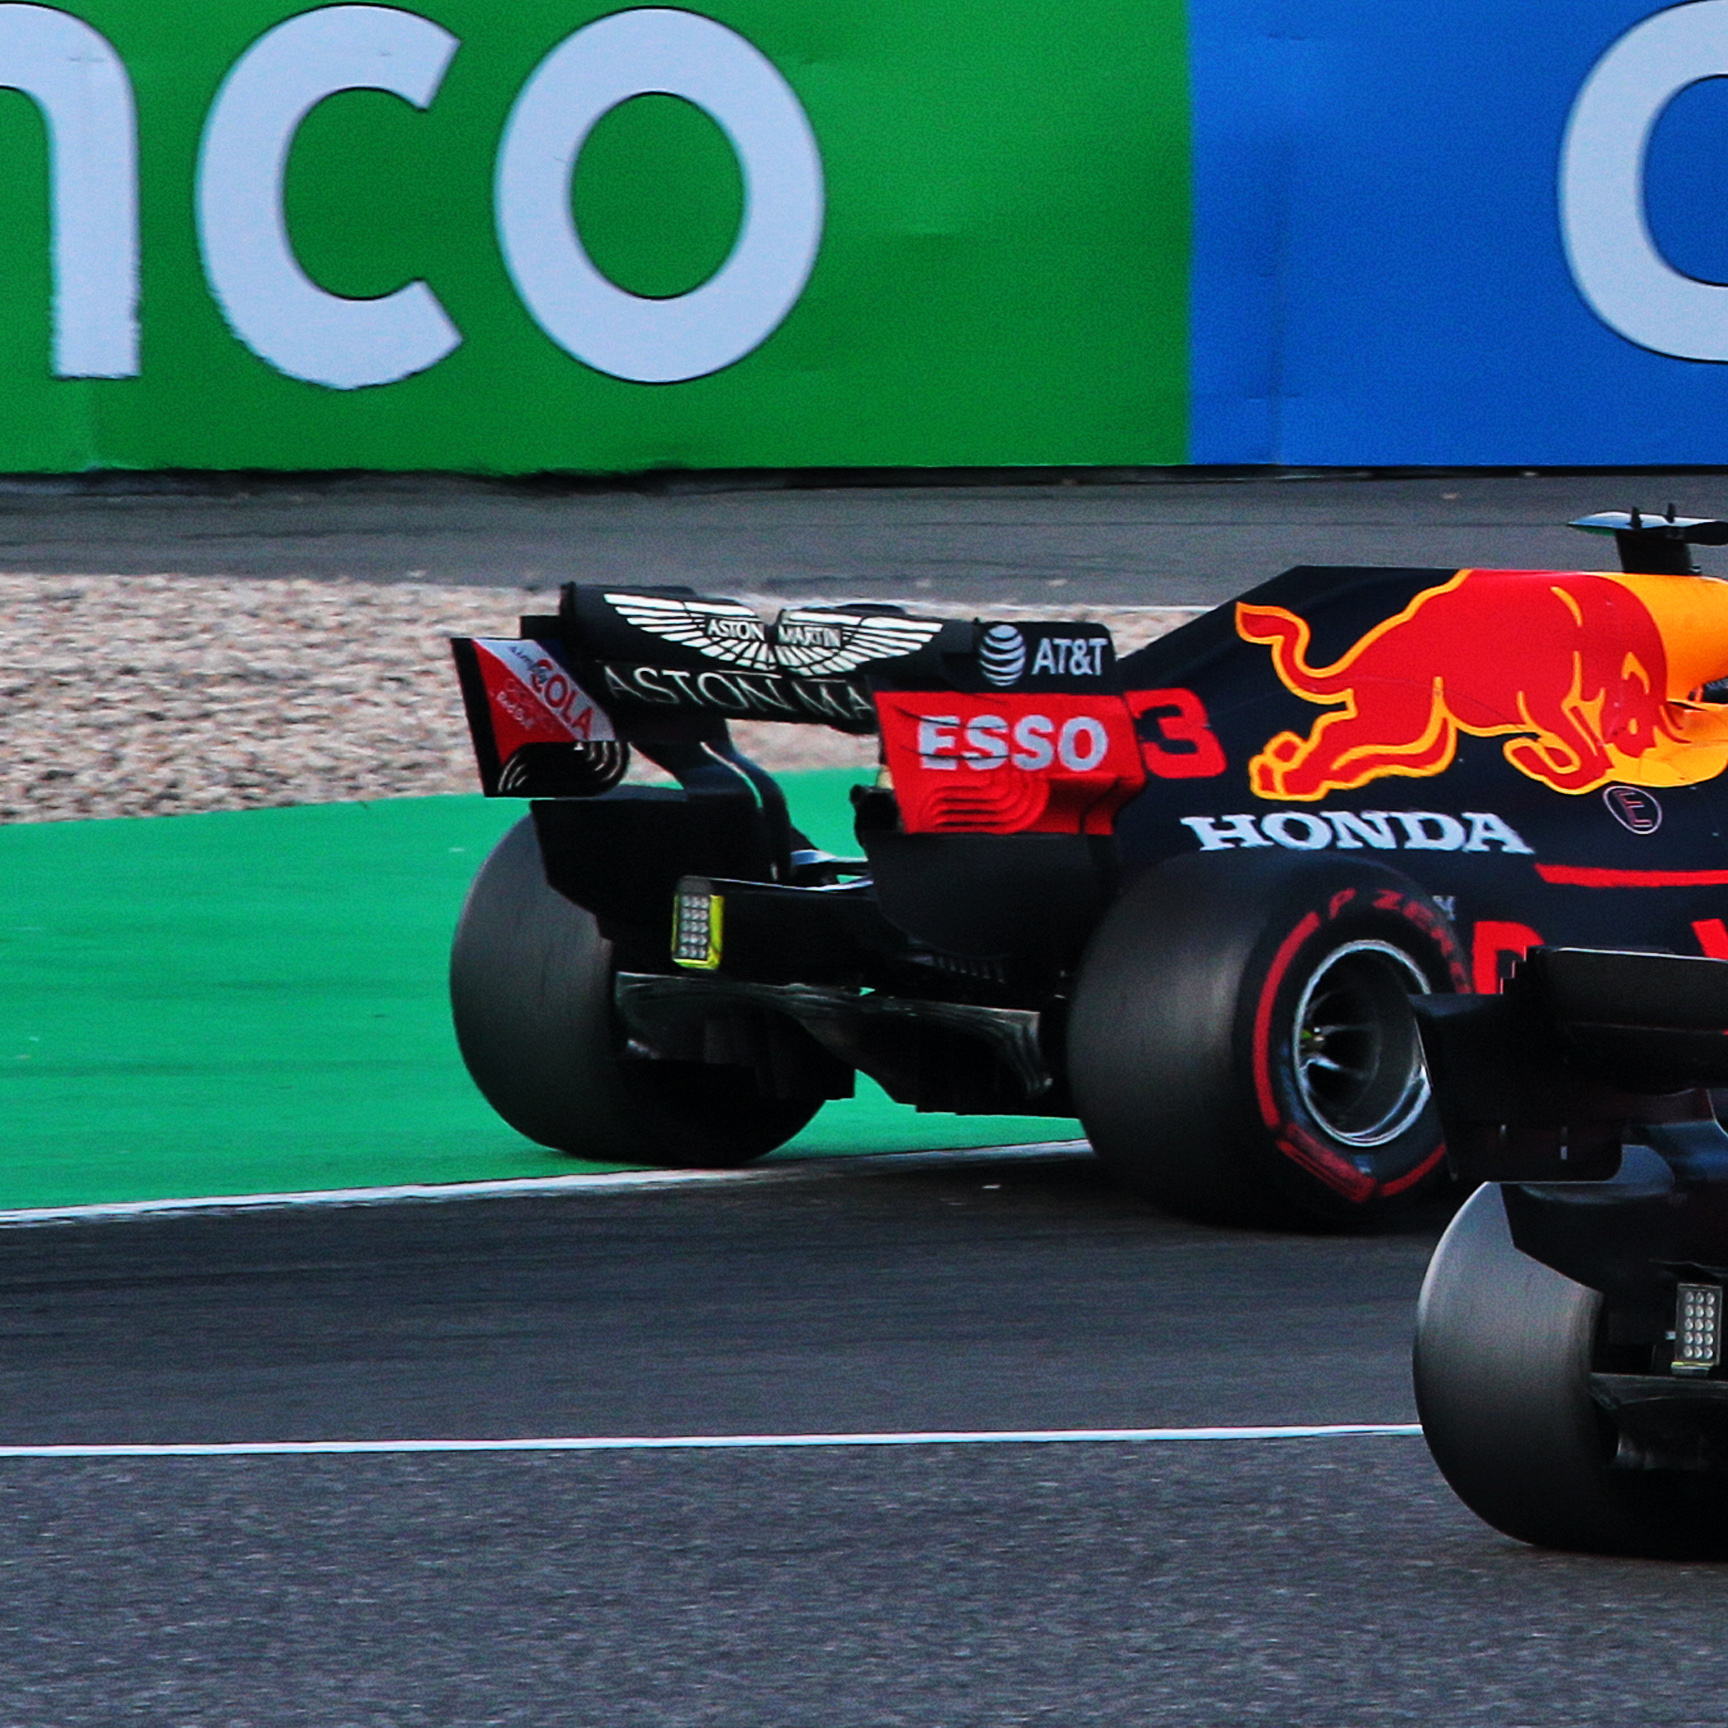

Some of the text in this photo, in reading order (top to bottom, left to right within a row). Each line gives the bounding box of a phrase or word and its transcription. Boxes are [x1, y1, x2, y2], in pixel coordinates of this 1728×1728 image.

[707, 617, 842, 648] ASTON MARTIN
[1032, 638, 1108, 675] AT&T
[604, 666, 798, 711] ASTON
[918, 715, 1109, 771] ESSO
[1179, 810, 1535, 854] HONDA
